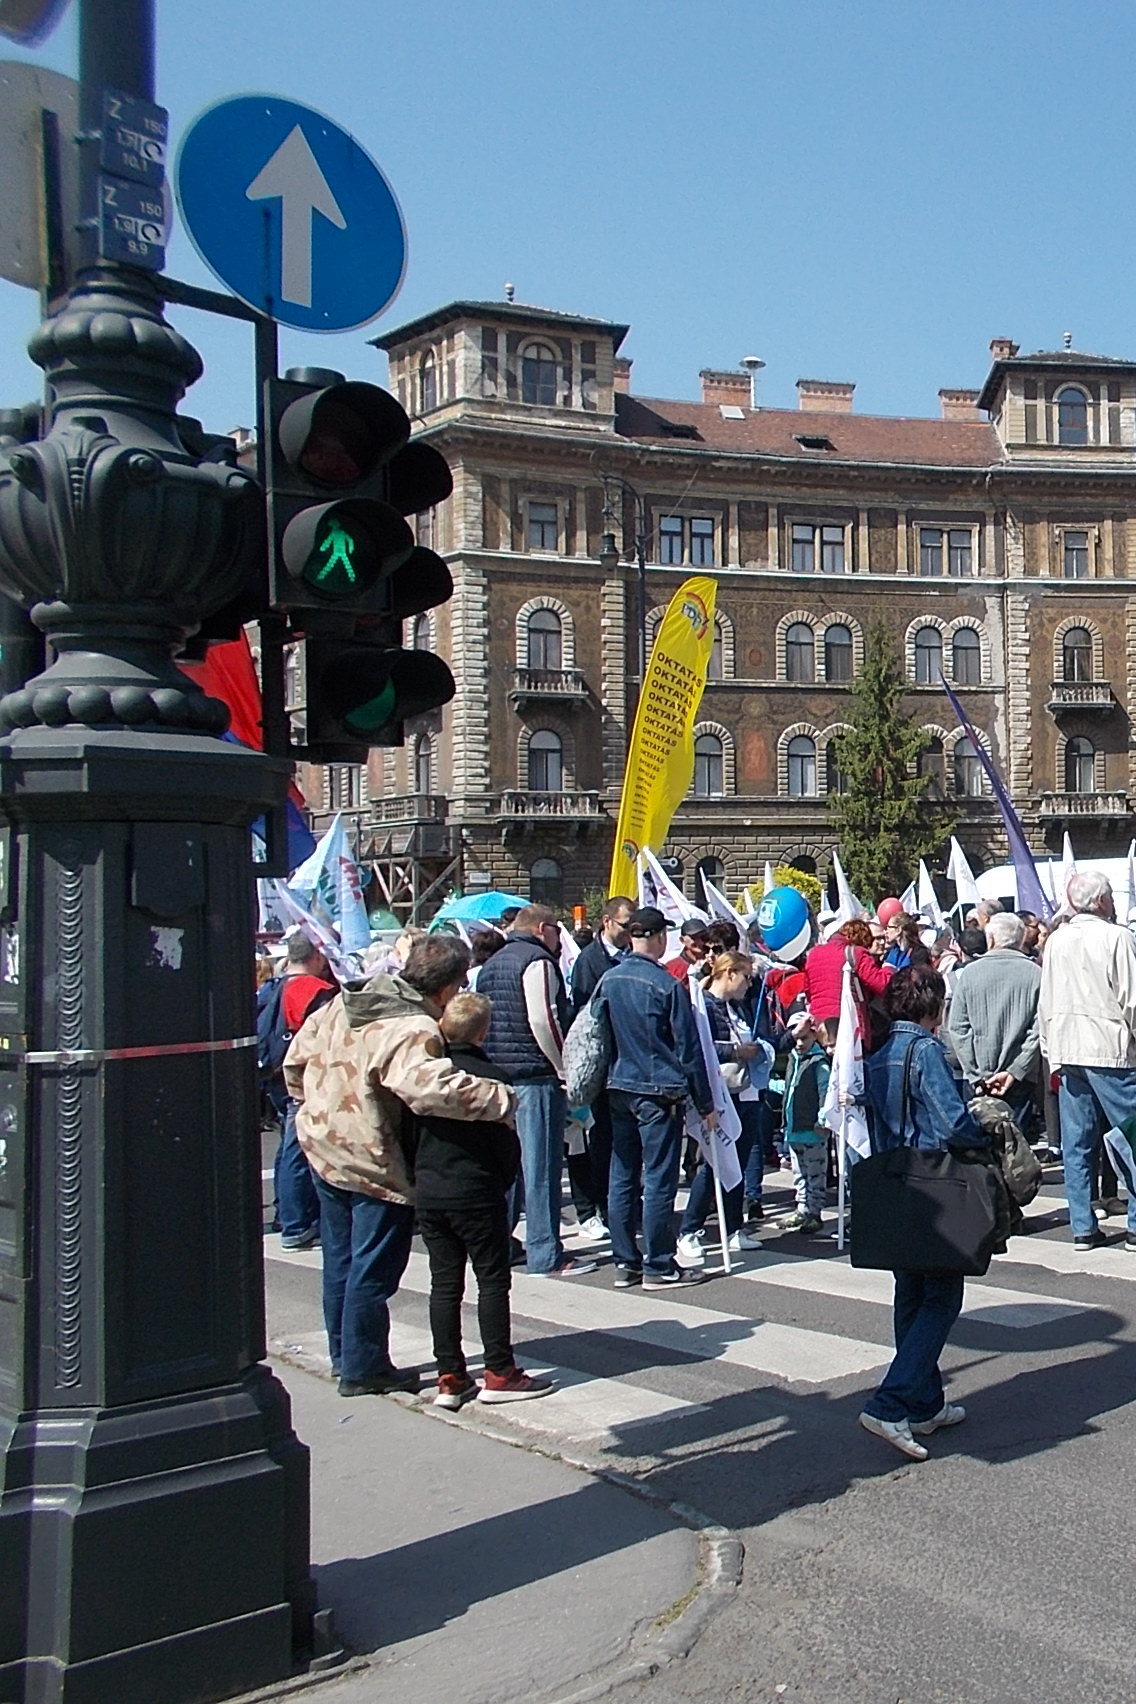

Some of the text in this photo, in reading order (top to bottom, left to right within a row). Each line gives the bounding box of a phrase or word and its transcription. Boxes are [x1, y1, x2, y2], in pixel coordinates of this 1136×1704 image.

[109, 97, 122, 120] Z
[104, 184, 119, 207] Z
[140, 200, 162, 217] 150
